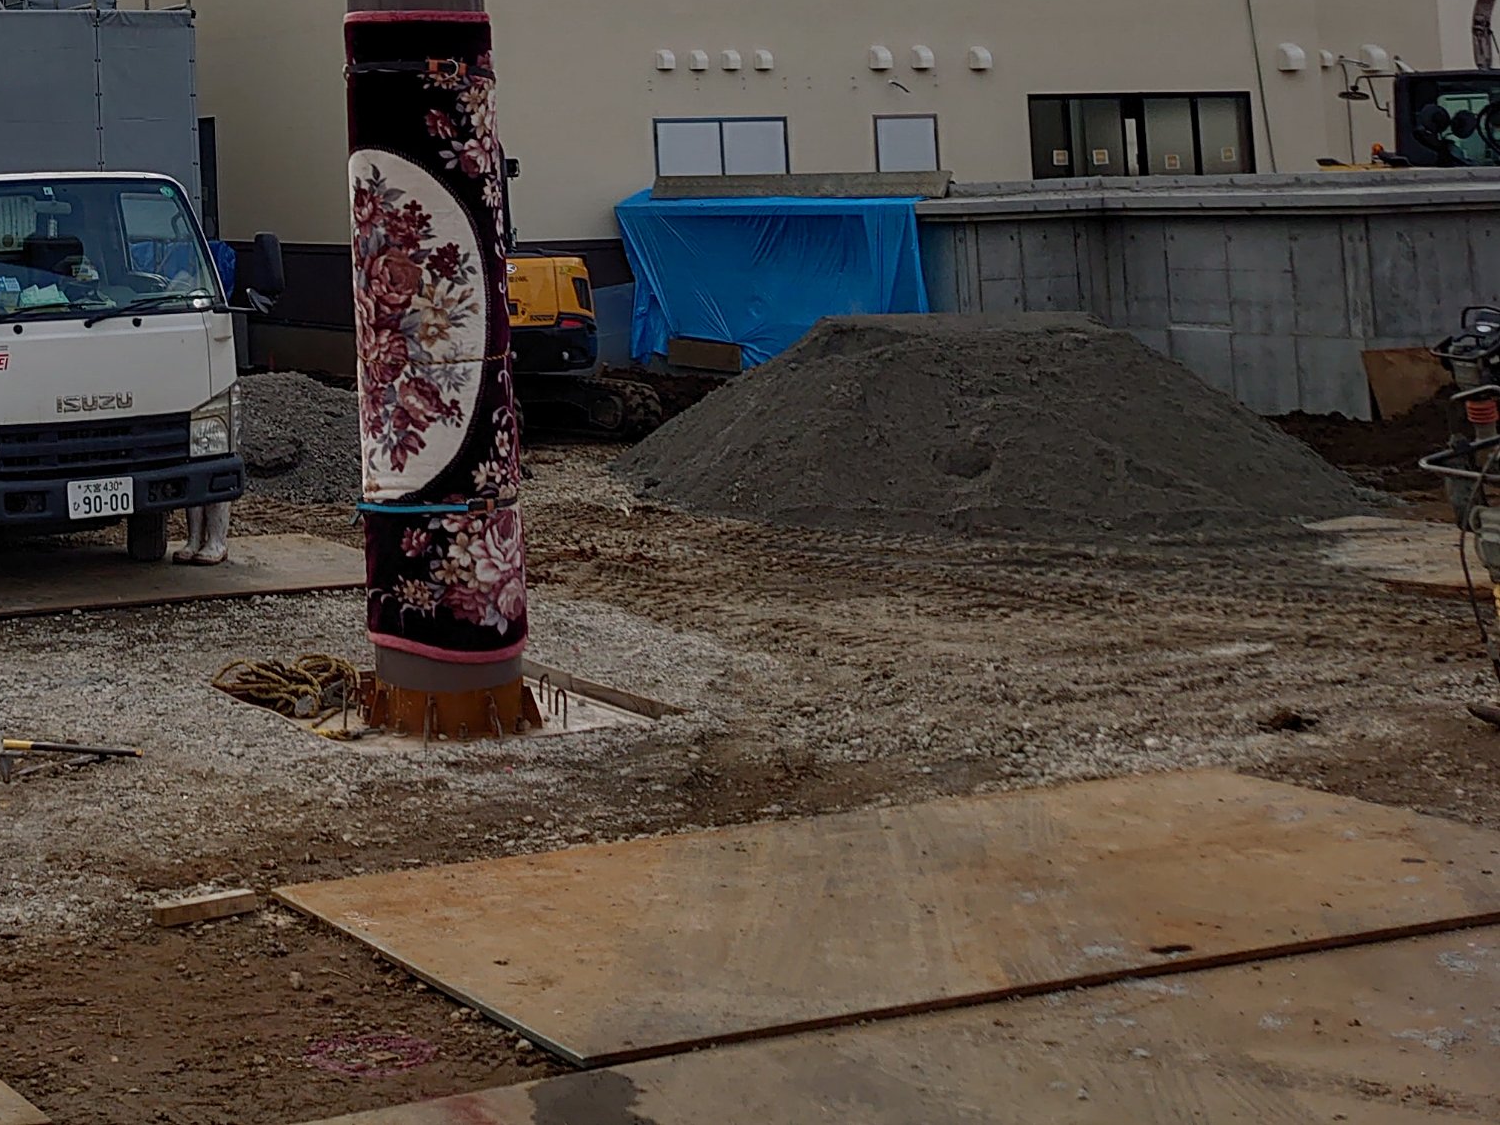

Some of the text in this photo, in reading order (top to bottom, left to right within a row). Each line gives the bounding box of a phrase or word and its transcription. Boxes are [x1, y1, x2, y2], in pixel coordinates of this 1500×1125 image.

[56, 391, 133, 413] ISUZU
[83, 481, 119, 495] 大宮 430
[82, 492, 130, 515] 90-00
